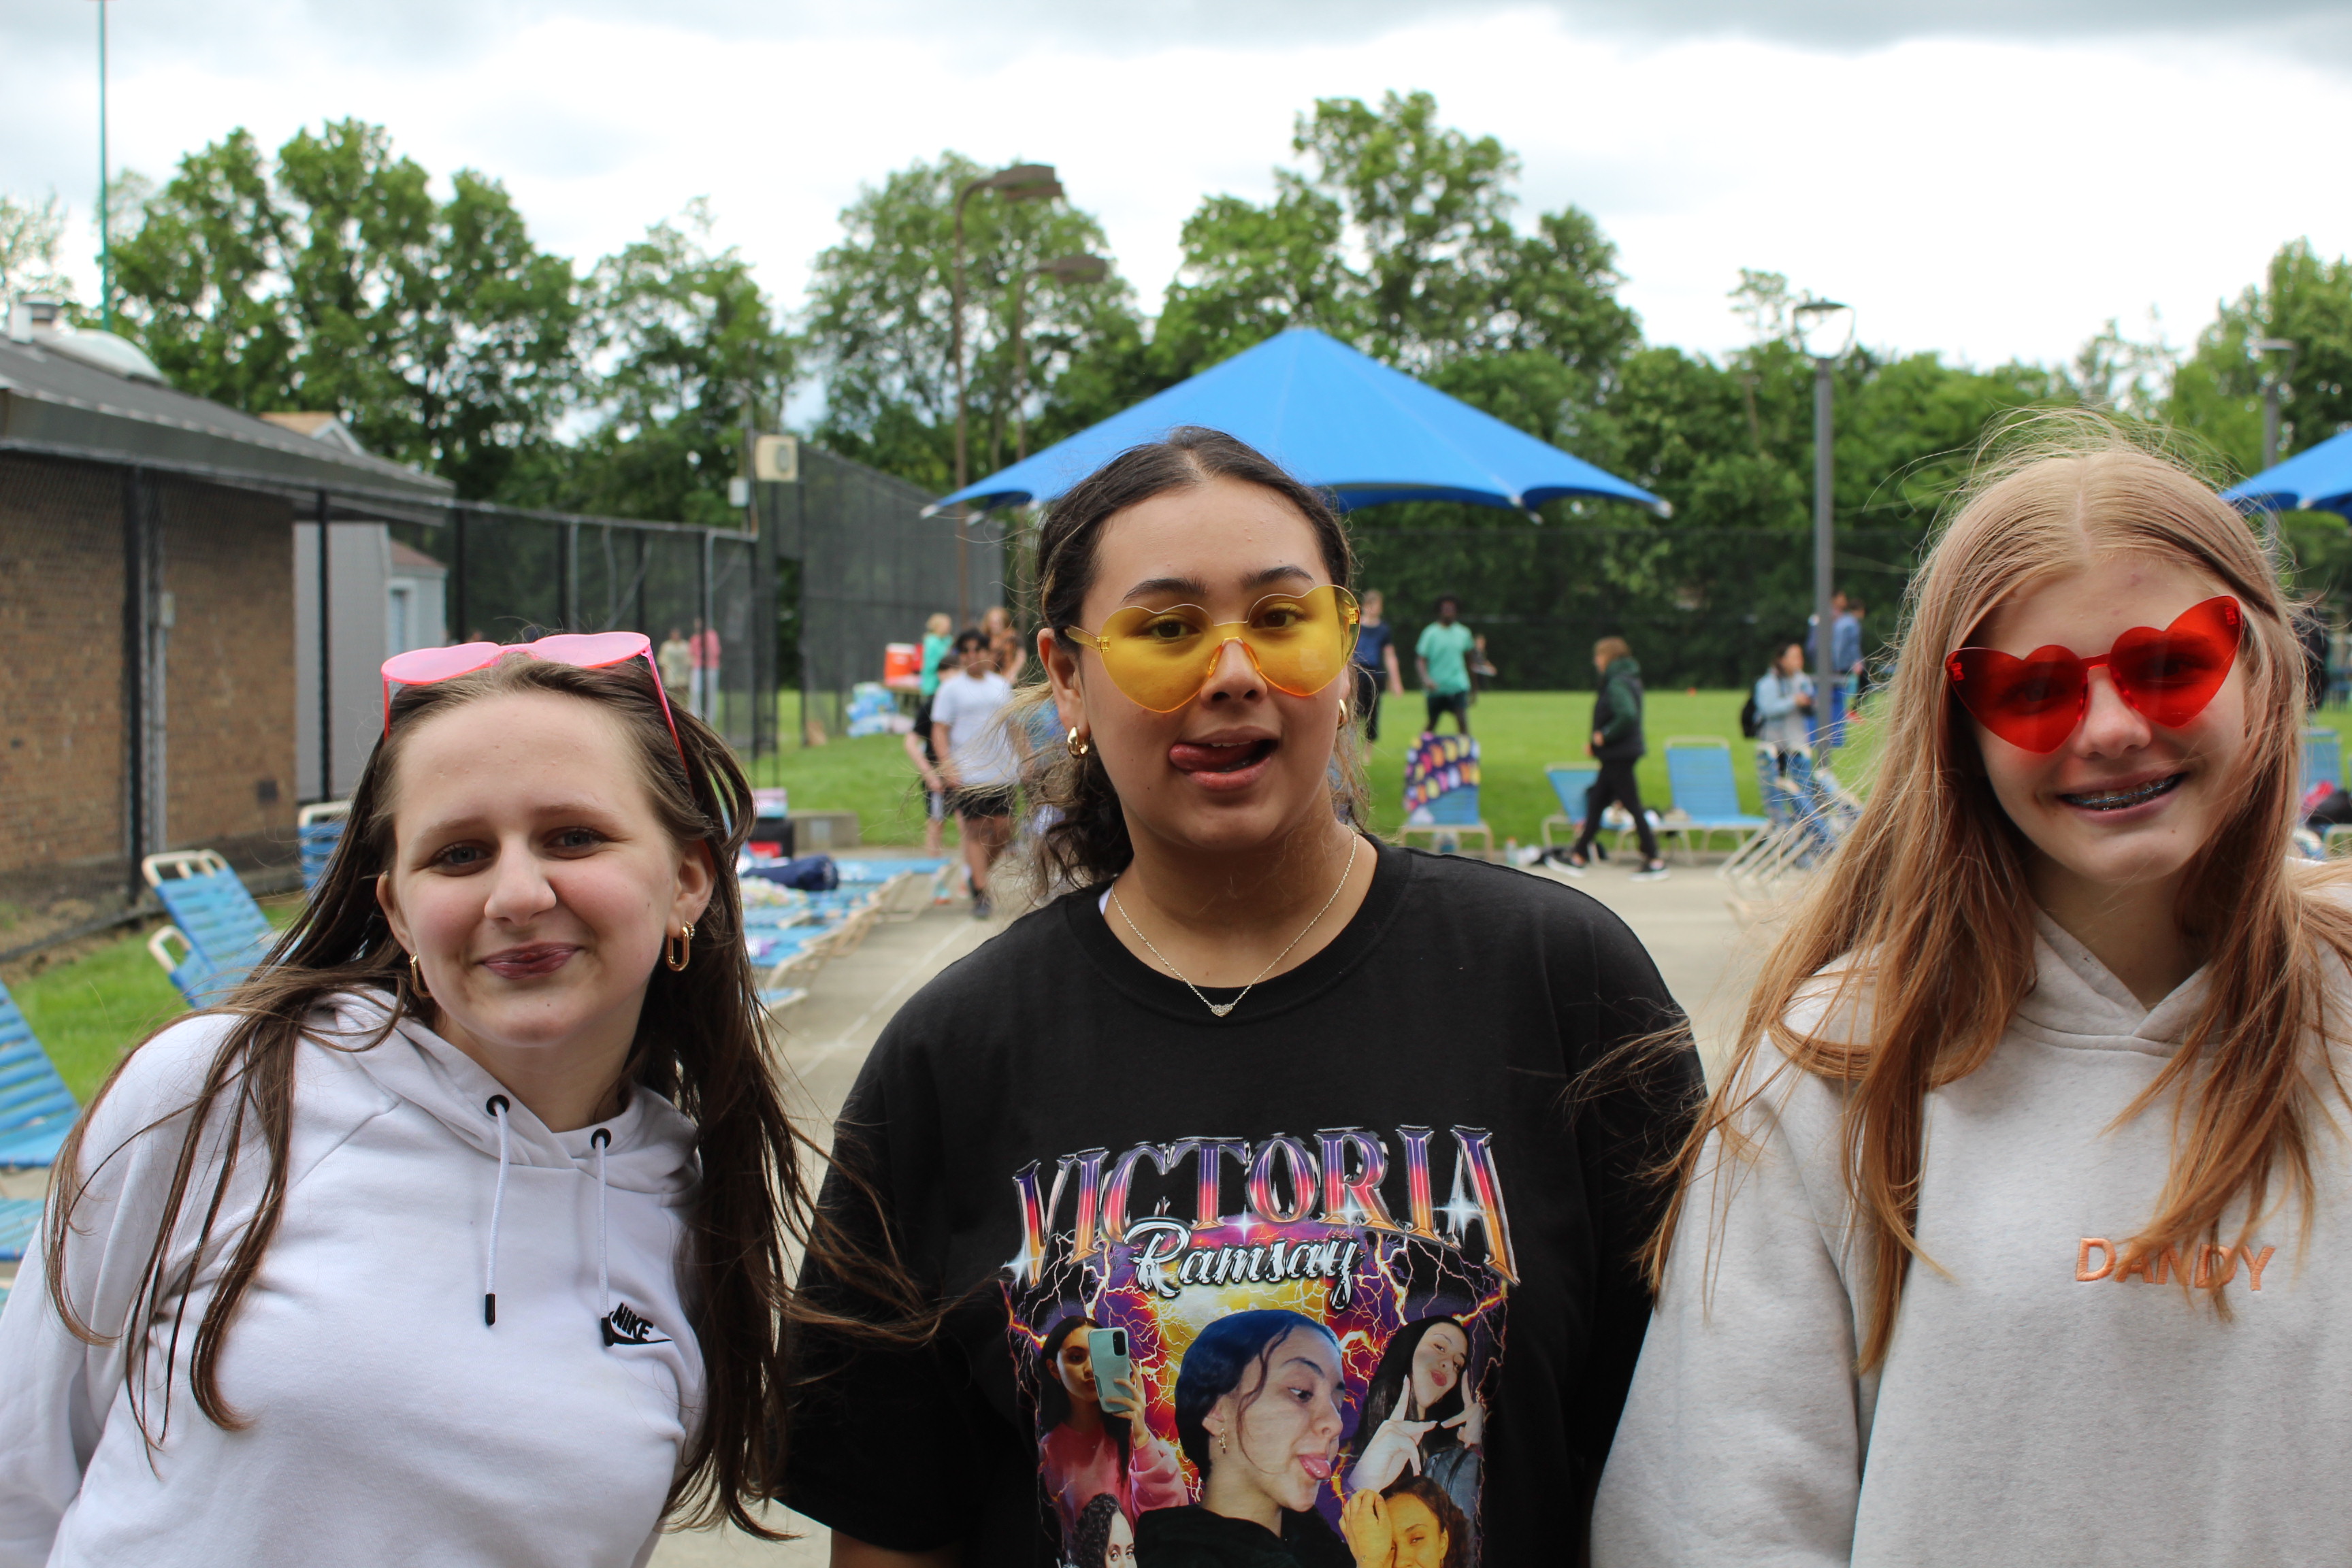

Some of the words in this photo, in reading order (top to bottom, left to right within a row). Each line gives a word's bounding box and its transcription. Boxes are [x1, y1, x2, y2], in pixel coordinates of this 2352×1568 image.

[1013, 1125, 1520, 1288] VICTORIA
[1123, 1218, 1365, 1311] Ramsay
[2075, 1237, 2276, 1291] DANDY
[611, 1302, 654, 1339] NIKE
